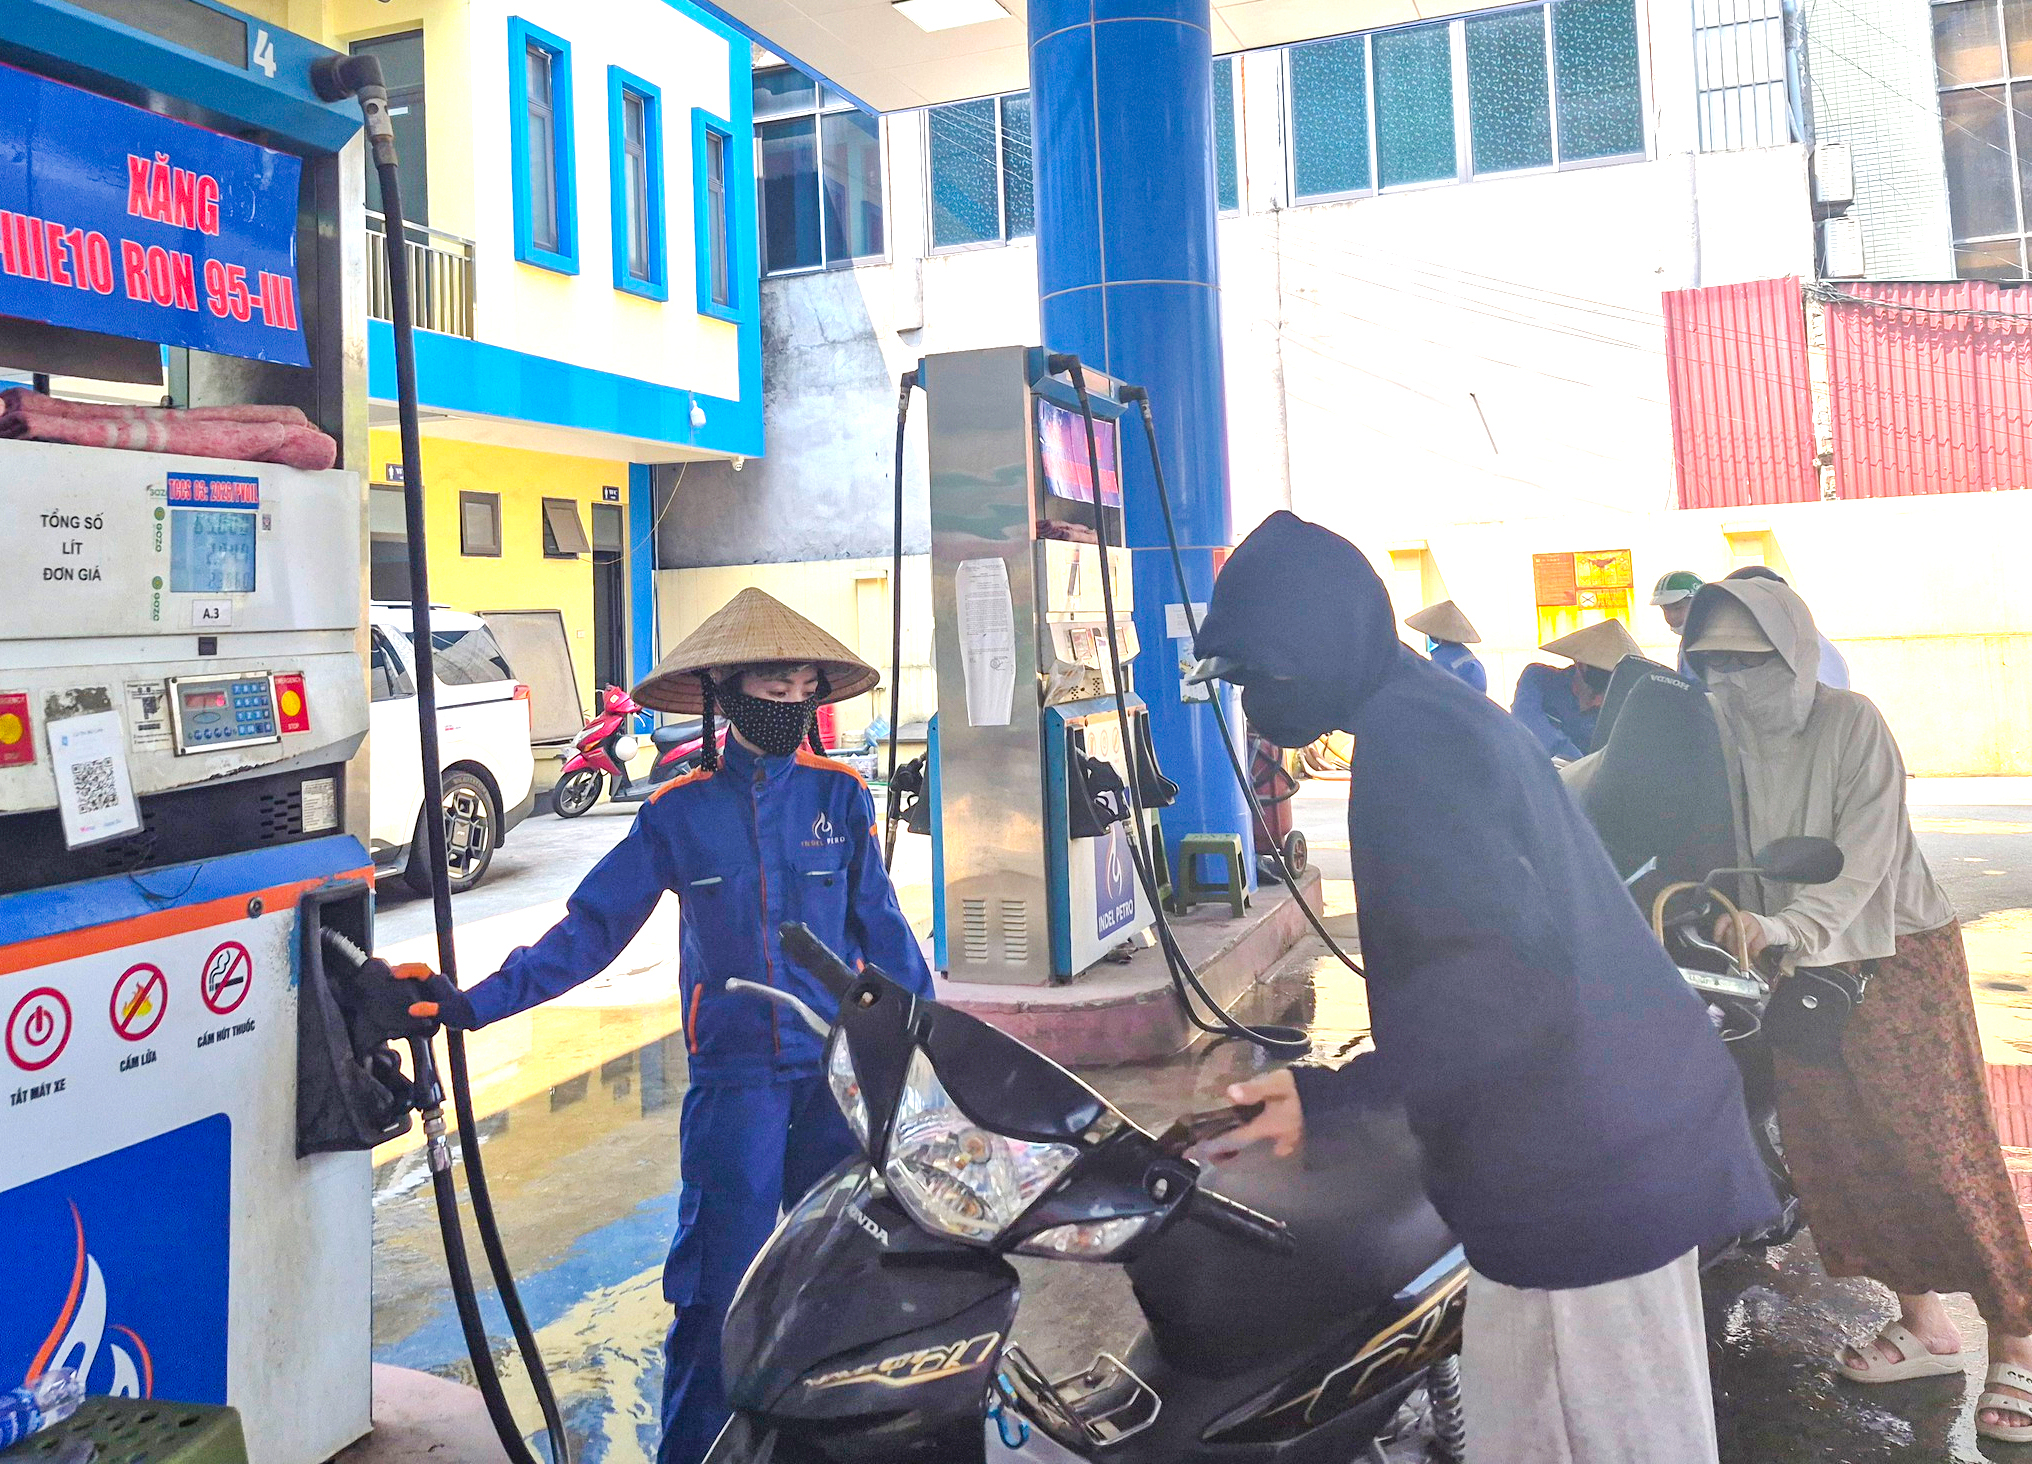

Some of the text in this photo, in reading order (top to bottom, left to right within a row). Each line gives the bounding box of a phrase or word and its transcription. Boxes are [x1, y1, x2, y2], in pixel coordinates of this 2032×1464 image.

[252, 29, 277, 78] 4
[127, 151, 219, 236] XĂNG
[0, 209, 298, 331] IIIE10 RON 95-III
[40, 508, 104, 530] TỔNG SỐ
[62, 539, 83, 555] LÍT
[43, 565, 102, 581] ĐƠN GIÁ
[202, 608, 219, 619] A.3
[1650, 674, 1690, 691] HONDA
[1098, 899, 1134, 933] INDEL PETRO
[197, 1031, 215, 1048] CẤM
[216, 1027, 231, 1042] HÚT
[119, 1054, 140, 1072] CẤM
[30, 1081, 51, 1101] MÁY
[53, 1077, 67, 1093] XE
